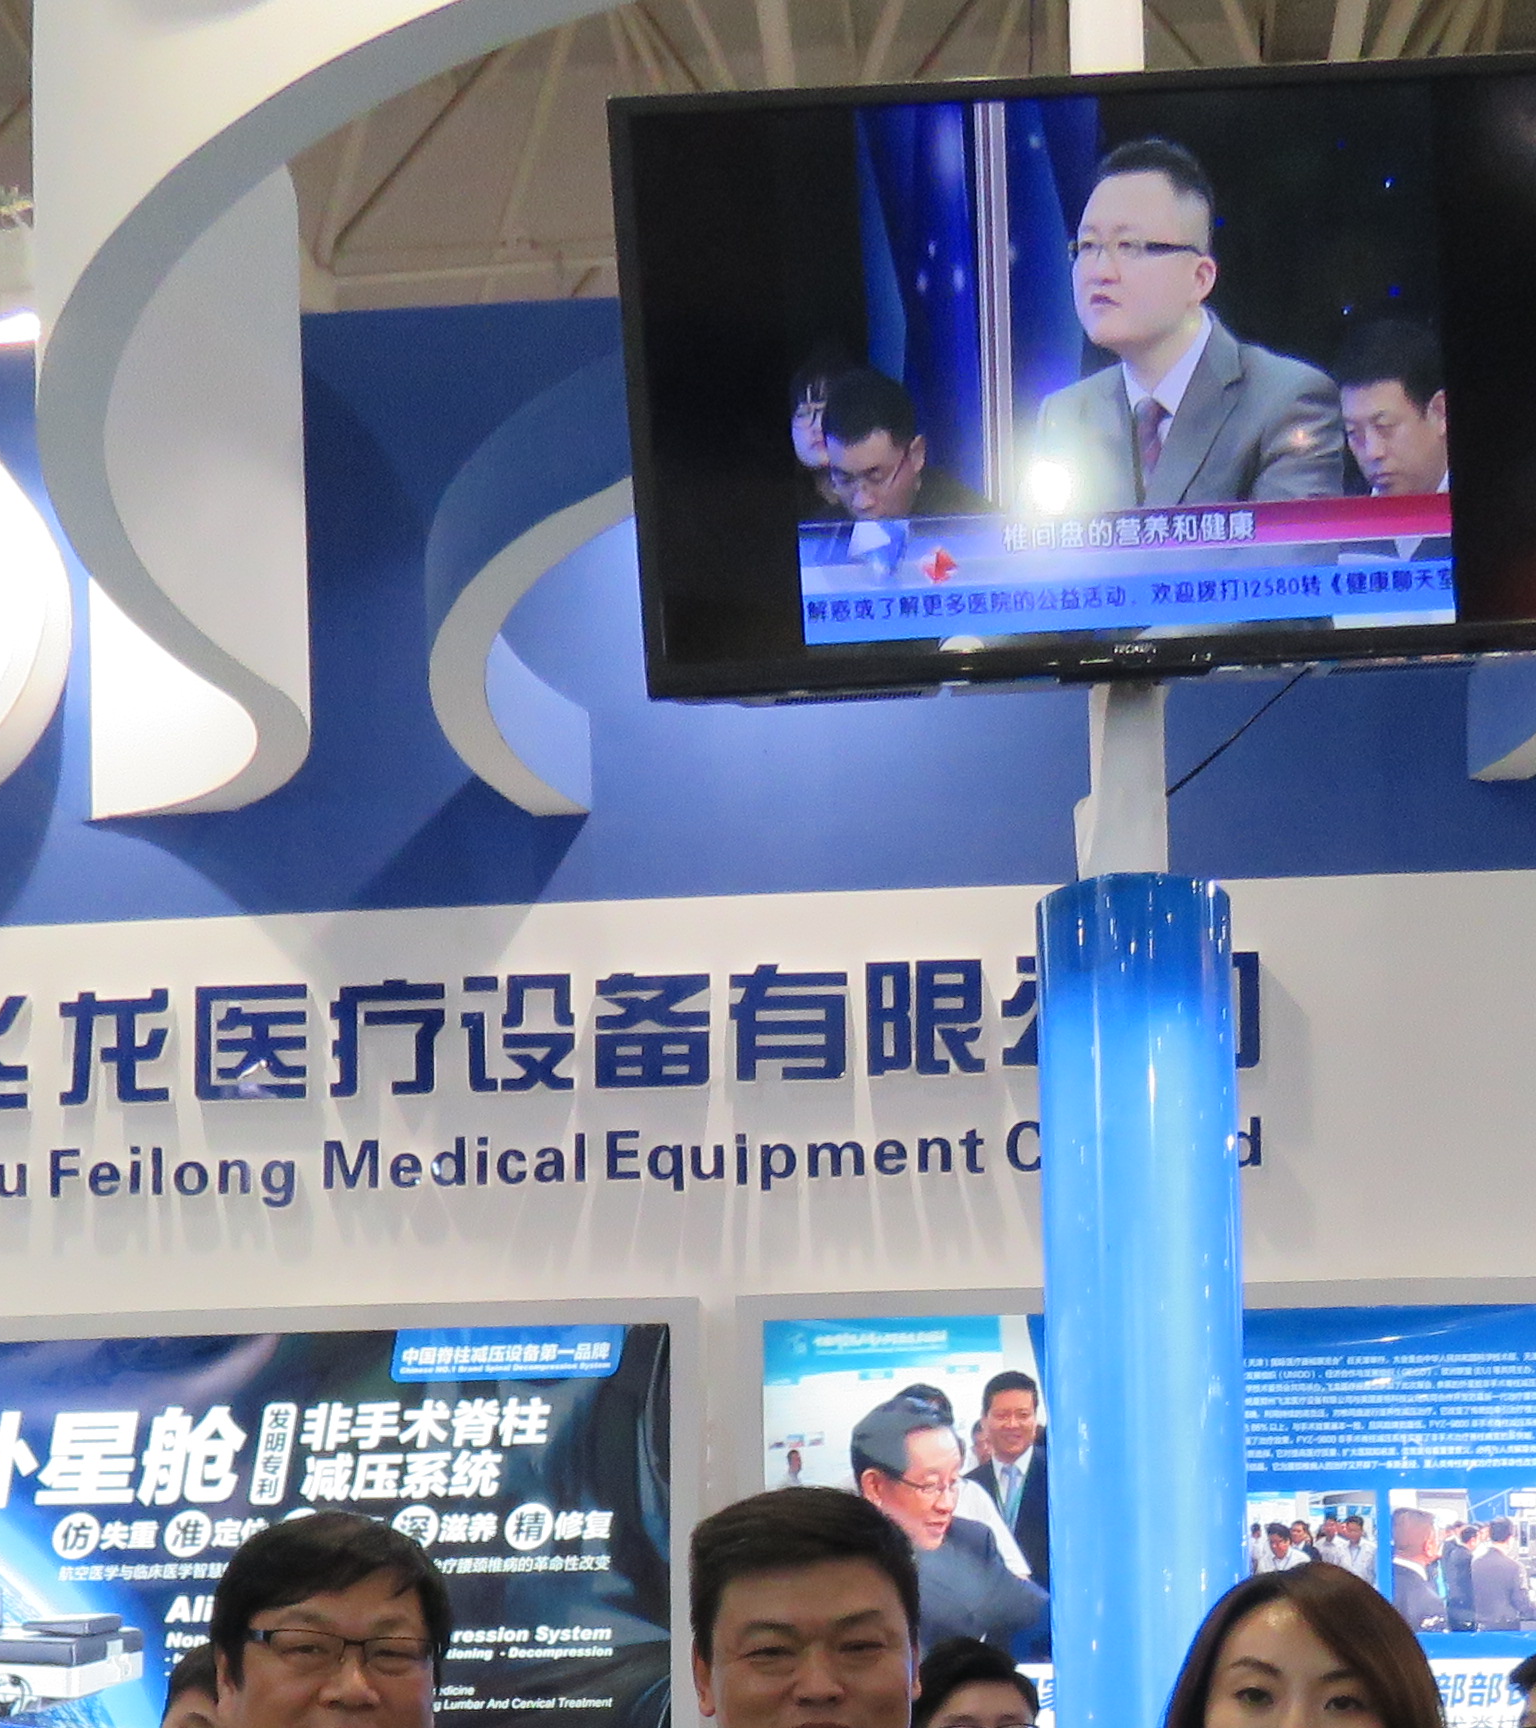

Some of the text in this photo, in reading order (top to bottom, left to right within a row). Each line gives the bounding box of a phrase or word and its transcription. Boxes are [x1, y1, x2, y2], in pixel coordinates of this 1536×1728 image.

[1002, 510, 1256, 551] 椎间盘的营养和健康
[49, 1145, 298, 1208] Feilong
[323, 1132, 585, 1191] Medical
[606, 1126, 985, 1192] Equipment
[402, 1342, 611, 1365] 中国脊柱减压设备第一品牌
[299, 1396, 552, 1451] 非手术脊柱
[257, 1407, 292, 1499] 发明专利
[299, 1450, 503, 1502] 减压系统
[58, 1562, 229, 1581] 航空医学与临床医学智慧
[165, 1594, 214, 1624] Ali
[166, 1625, 613, 1649] Non- ression System
[445, 1645, 613, 1661] tioning Decompression
[444, 1697, 613, 1711] Lumbar And Cervical Treatment
